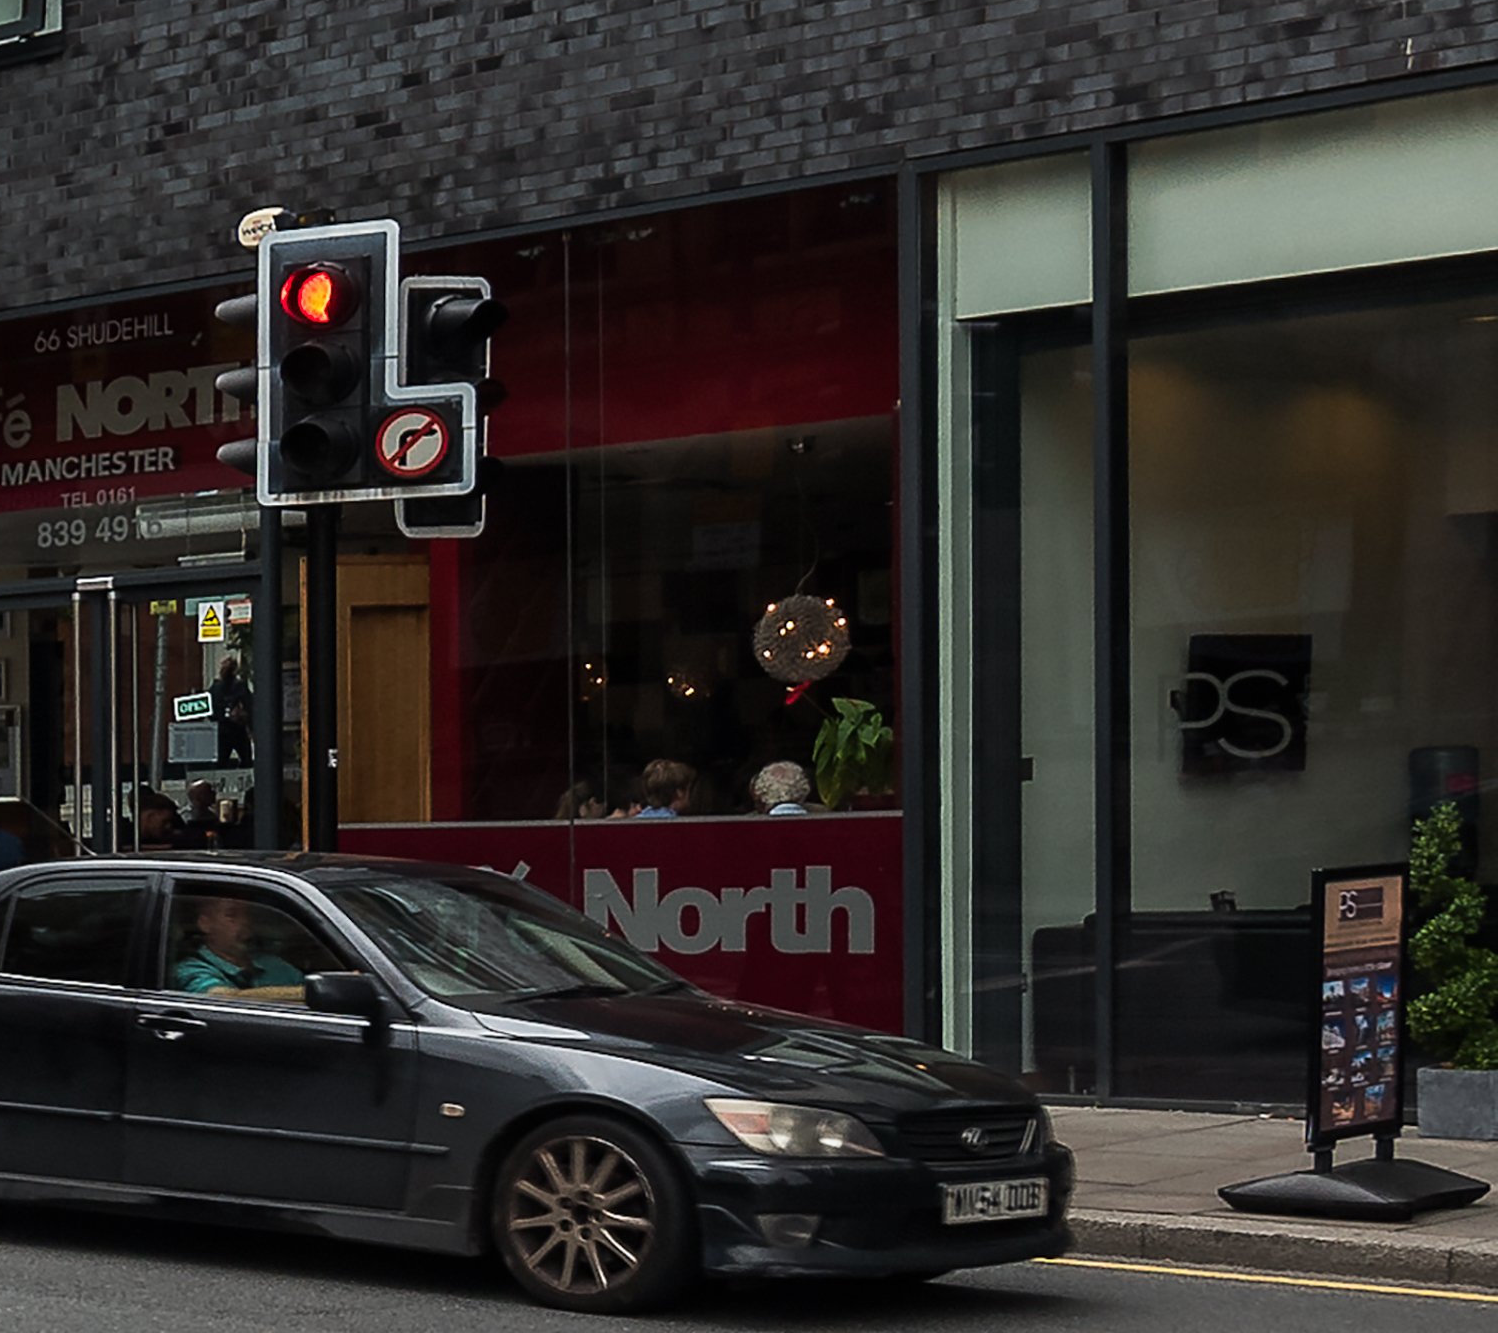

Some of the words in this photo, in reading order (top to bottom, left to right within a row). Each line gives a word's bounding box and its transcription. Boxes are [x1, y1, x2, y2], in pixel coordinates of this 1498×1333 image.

[34, 332, 60, 353] 66
[66, 312, 174, 349] SHUDEHILL
[1, 447, 175, 486] MANCHESTER
[61, 491, 93, 509] TEL
[96, 486, 136, 505] 0161
[37, 520, 86, 548] 839
[179, 699, 209, 713] OPEN
[584, 866, 875, 953] North
